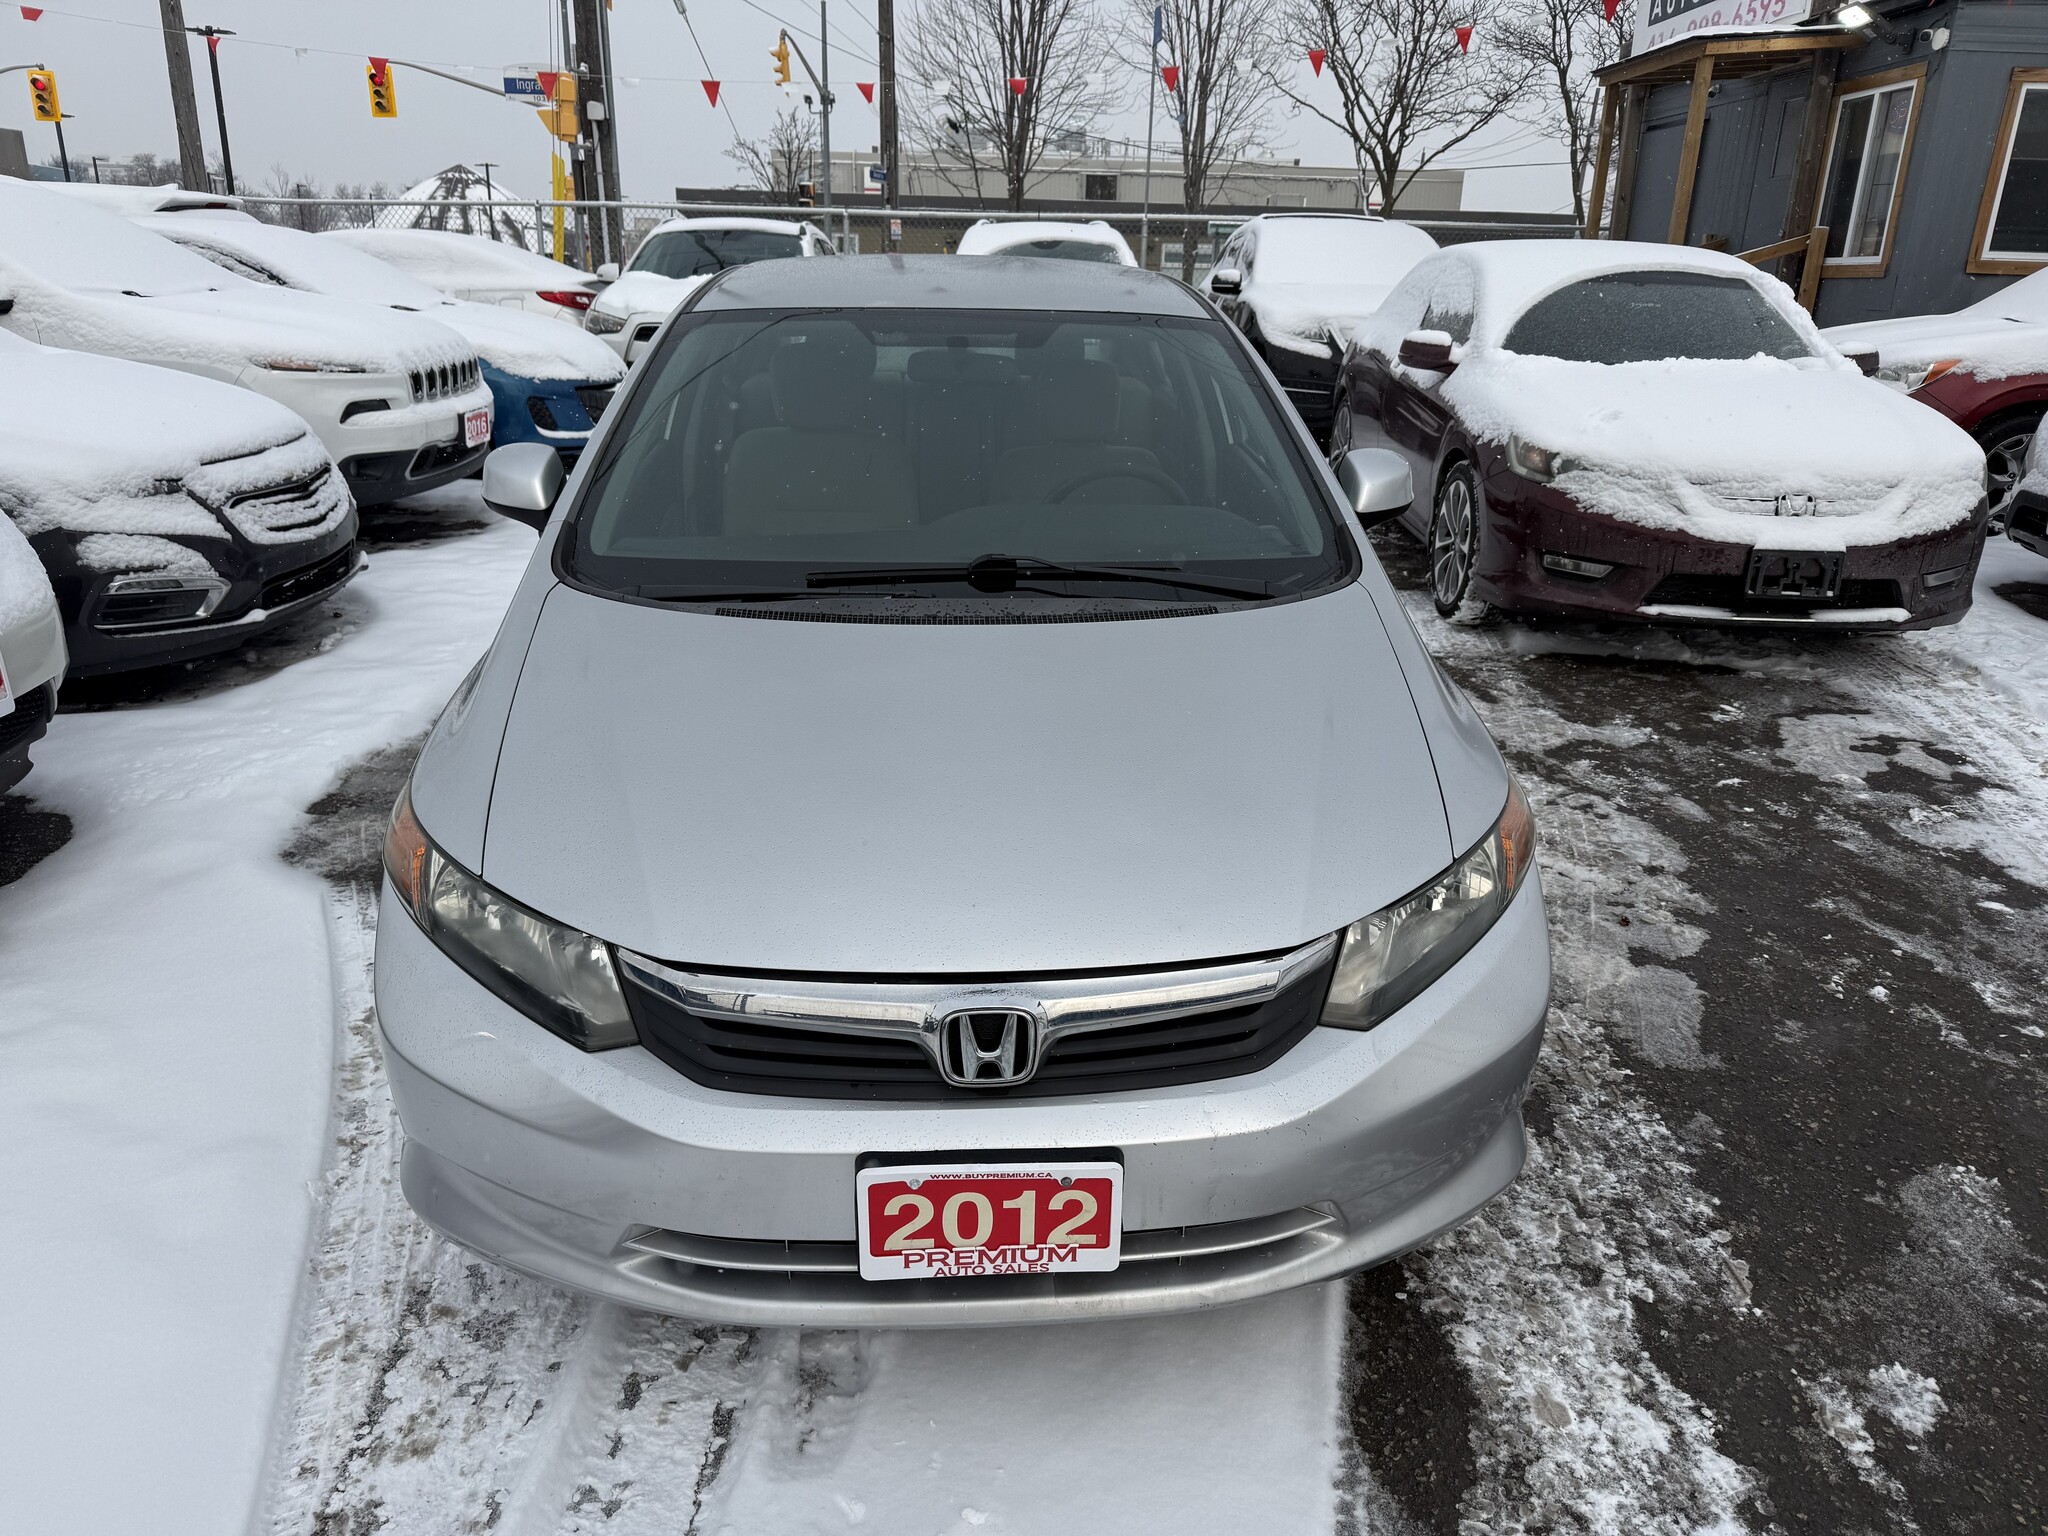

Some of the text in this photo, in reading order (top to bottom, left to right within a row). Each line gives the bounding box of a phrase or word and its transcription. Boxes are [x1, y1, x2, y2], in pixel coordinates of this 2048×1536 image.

[1652, 0, 1698, 19] AU
[516, 79, 543, 92] Ingra
[467, 416, 487, 436] 2016
[930, 1172, 1053, 1180] WWW.BUYPREMIUM.CA
[883, 1190, 1098, 1250] 2012
[902, 1244, 1079, 1269] PREMIUM
[934, 1262, 1050, 1277] AUTO SALES
